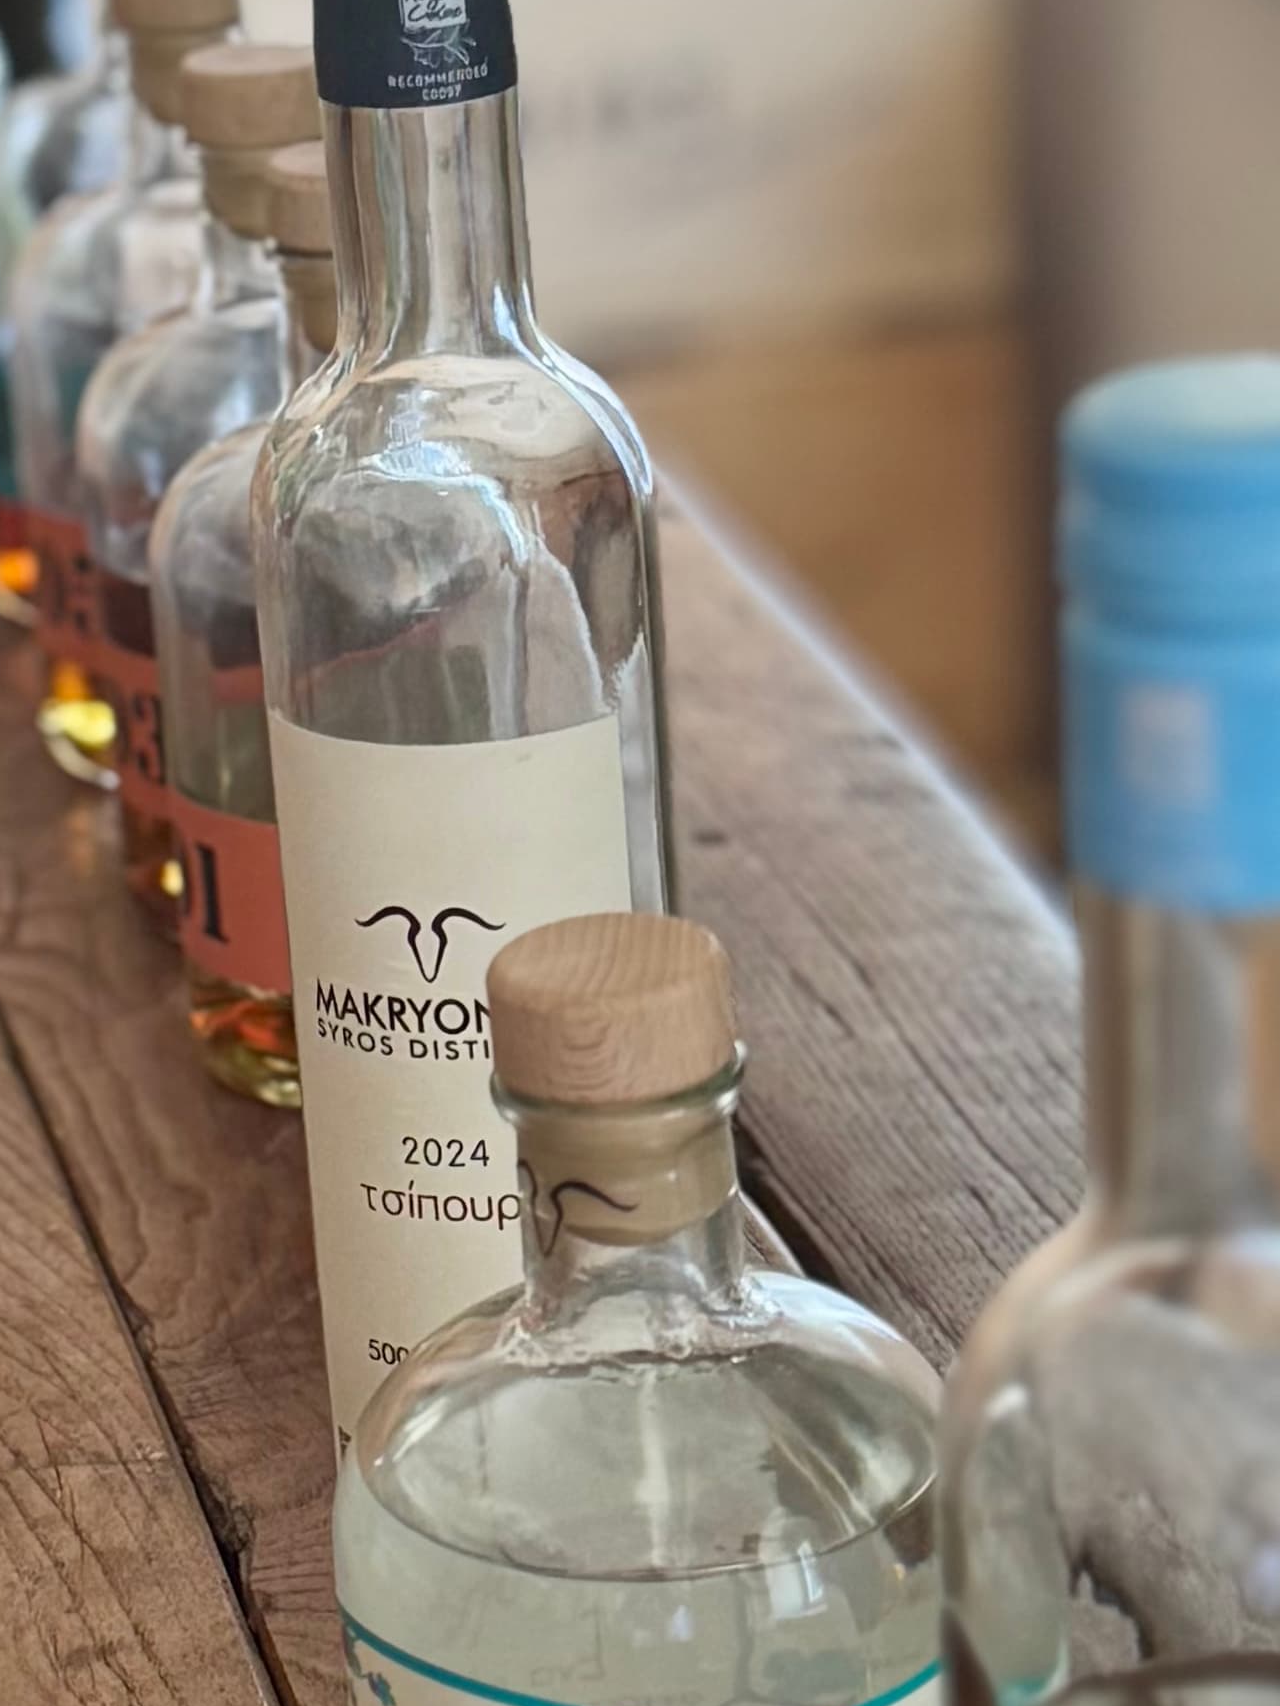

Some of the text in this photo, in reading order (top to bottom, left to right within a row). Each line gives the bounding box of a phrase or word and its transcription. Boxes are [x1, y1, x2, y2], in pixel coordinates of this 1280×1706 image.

[317, 1017, 490, 1061] SYROS DISTI
[401, 1135, 490, 1168] 2024
